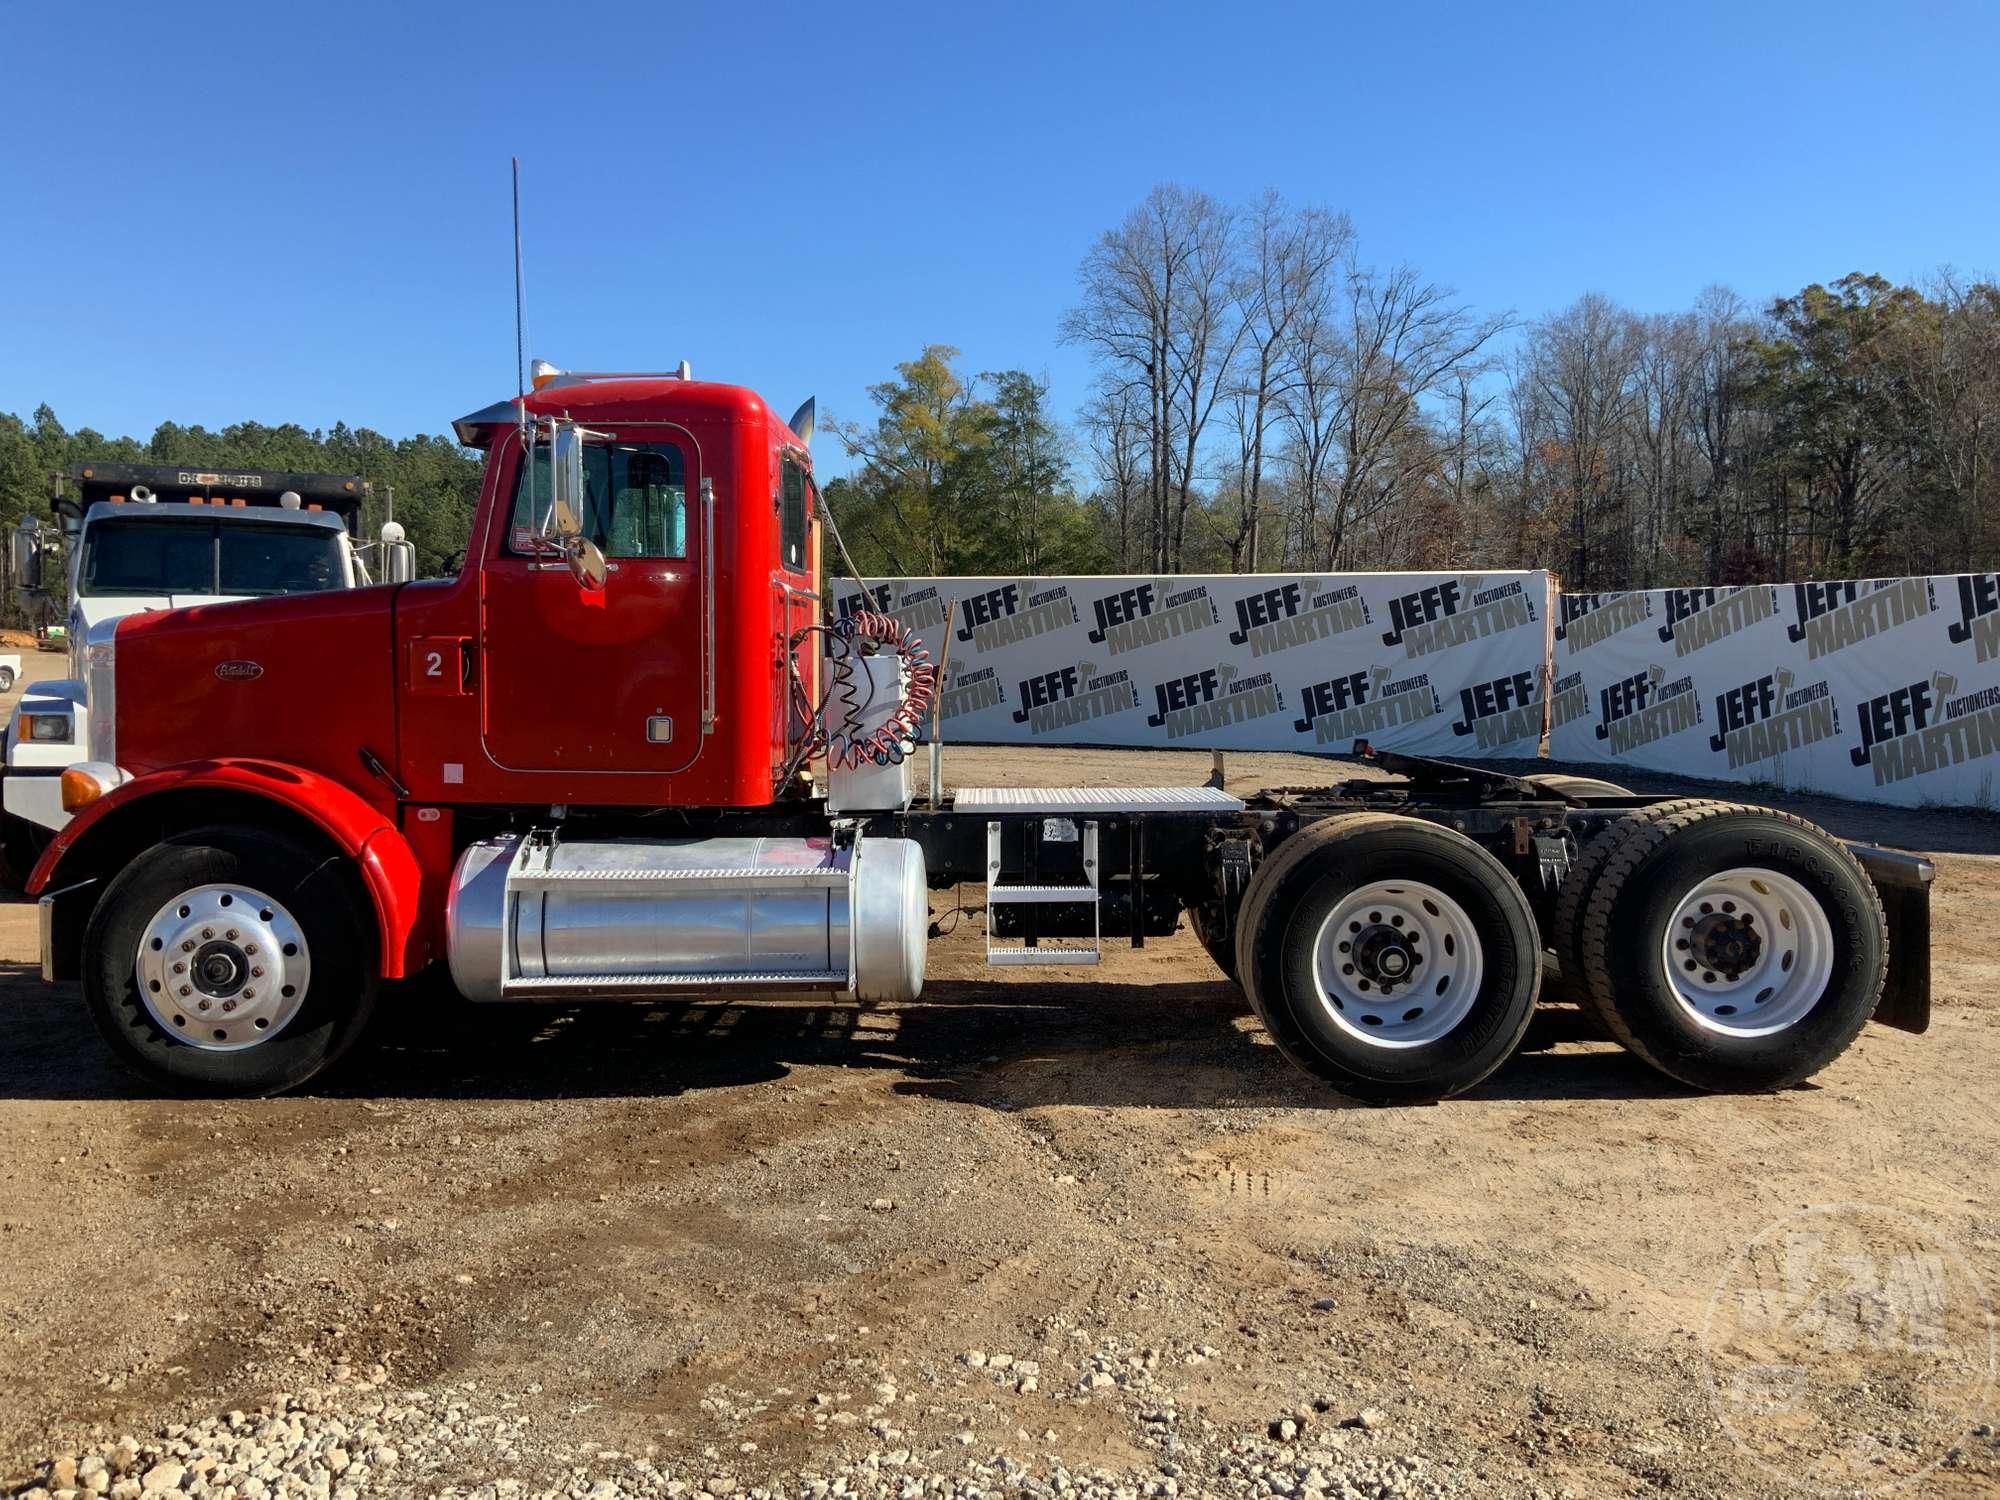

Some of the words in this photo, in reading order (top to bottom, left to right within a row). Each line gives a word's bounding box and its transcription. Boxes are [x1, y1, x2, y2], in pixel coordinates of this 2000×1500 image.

[957, 583, 1019, 641] JEFF
[973, 598, 1073, 653] MARTIN
[1088, 583, 1155, 644] JEFF
[1104, 599, 1214, 656] MARTIN
[1229, 582, 1301, 645] JEFF
[1247, 598, 1365, 658] MARTIN
[1382, 580, 1460, 647] JEFF
[1401, 594, 1529, 659] MARTIN
[1672, 586, 1773, 657] MARTIN
[1806, 577, 1928, 661] MARTIN
[1948, 575, 2000, 644] JE
[425, 652, 442, 676] 2
[1012, 666, 1078, 723] JEFF
[1028, 682, 1134, 735] MARTIN
[1147, 668, 1218, 727] JEFF
[1166, 685, 1278, 739] MARTIN
[1294, 671, 1370, 733] JEFF
[1313, 687, 1435, 744] MARTIN
[1452, 671, 1534, 736] JEFF
[1595, 671, 1649, 740] JEFF
[1608, 691, 1697, 756] MARTIN
[1709, 674, 1775, 752] JEFF
[1849, 680, 1932, 767] JEFF
[1725, 696, 1834, 770] MARTIN
